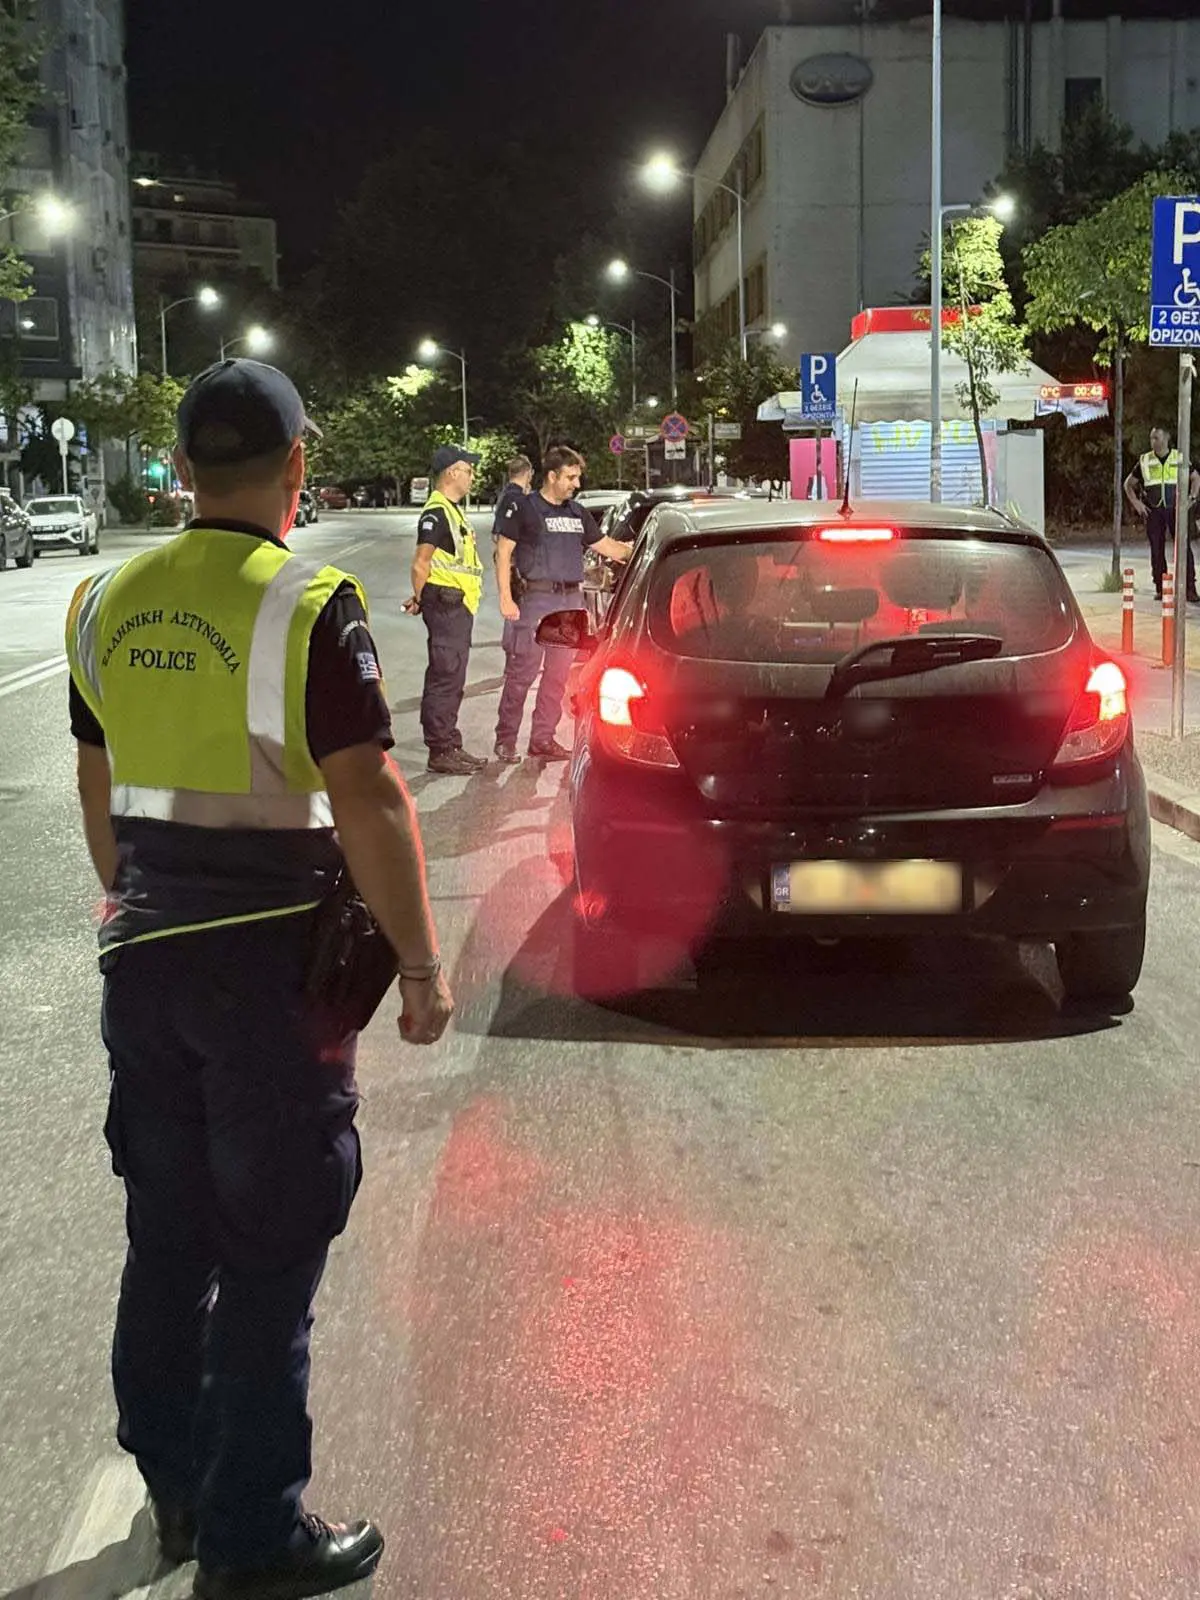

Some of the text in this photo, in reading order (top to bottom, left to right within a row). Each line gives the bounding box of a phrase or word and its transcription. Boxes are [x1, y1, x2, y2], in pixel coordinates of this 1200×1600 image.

[1173, 202, 1200, 264] P
[1158, 311, 1167, 325] 2
[810, 355, 827, 384] P
[102, 609, 240, 674] ΕΛΛΗΝΙΚΗ ΑΣΤΥΝΟΜΙΑ
[128, 648, 197, 671] POLICE
[776, 887, 789, 897] GR
